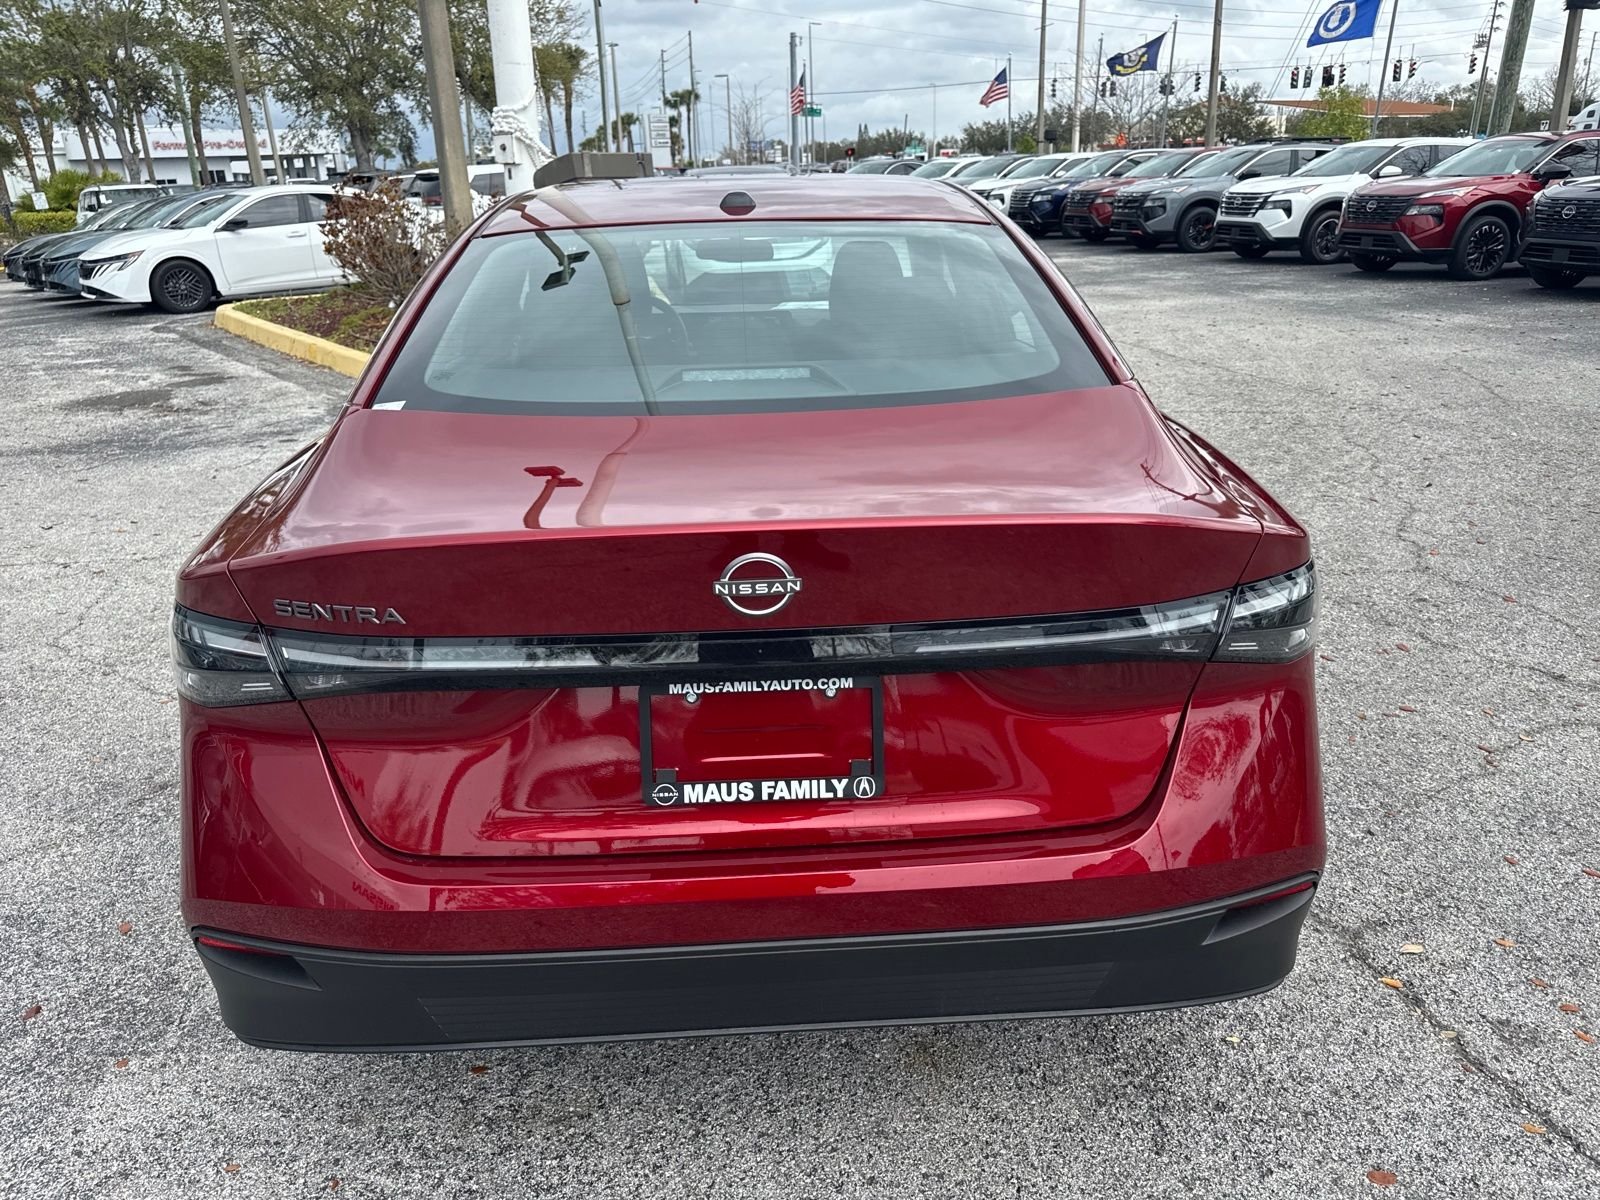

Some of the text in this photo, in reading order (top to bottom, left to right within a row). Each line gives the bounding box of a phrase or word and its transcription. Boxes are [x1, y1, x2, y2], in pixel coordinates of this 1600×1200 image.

[715, 580, 800, 594] NISSAN
[273, 599, 407, 624] SENTRA
[668, 677, 853, 695] MAUSFAMILYAUTO.COM
[683, 778, 849, 804] MAUS FAMILY
